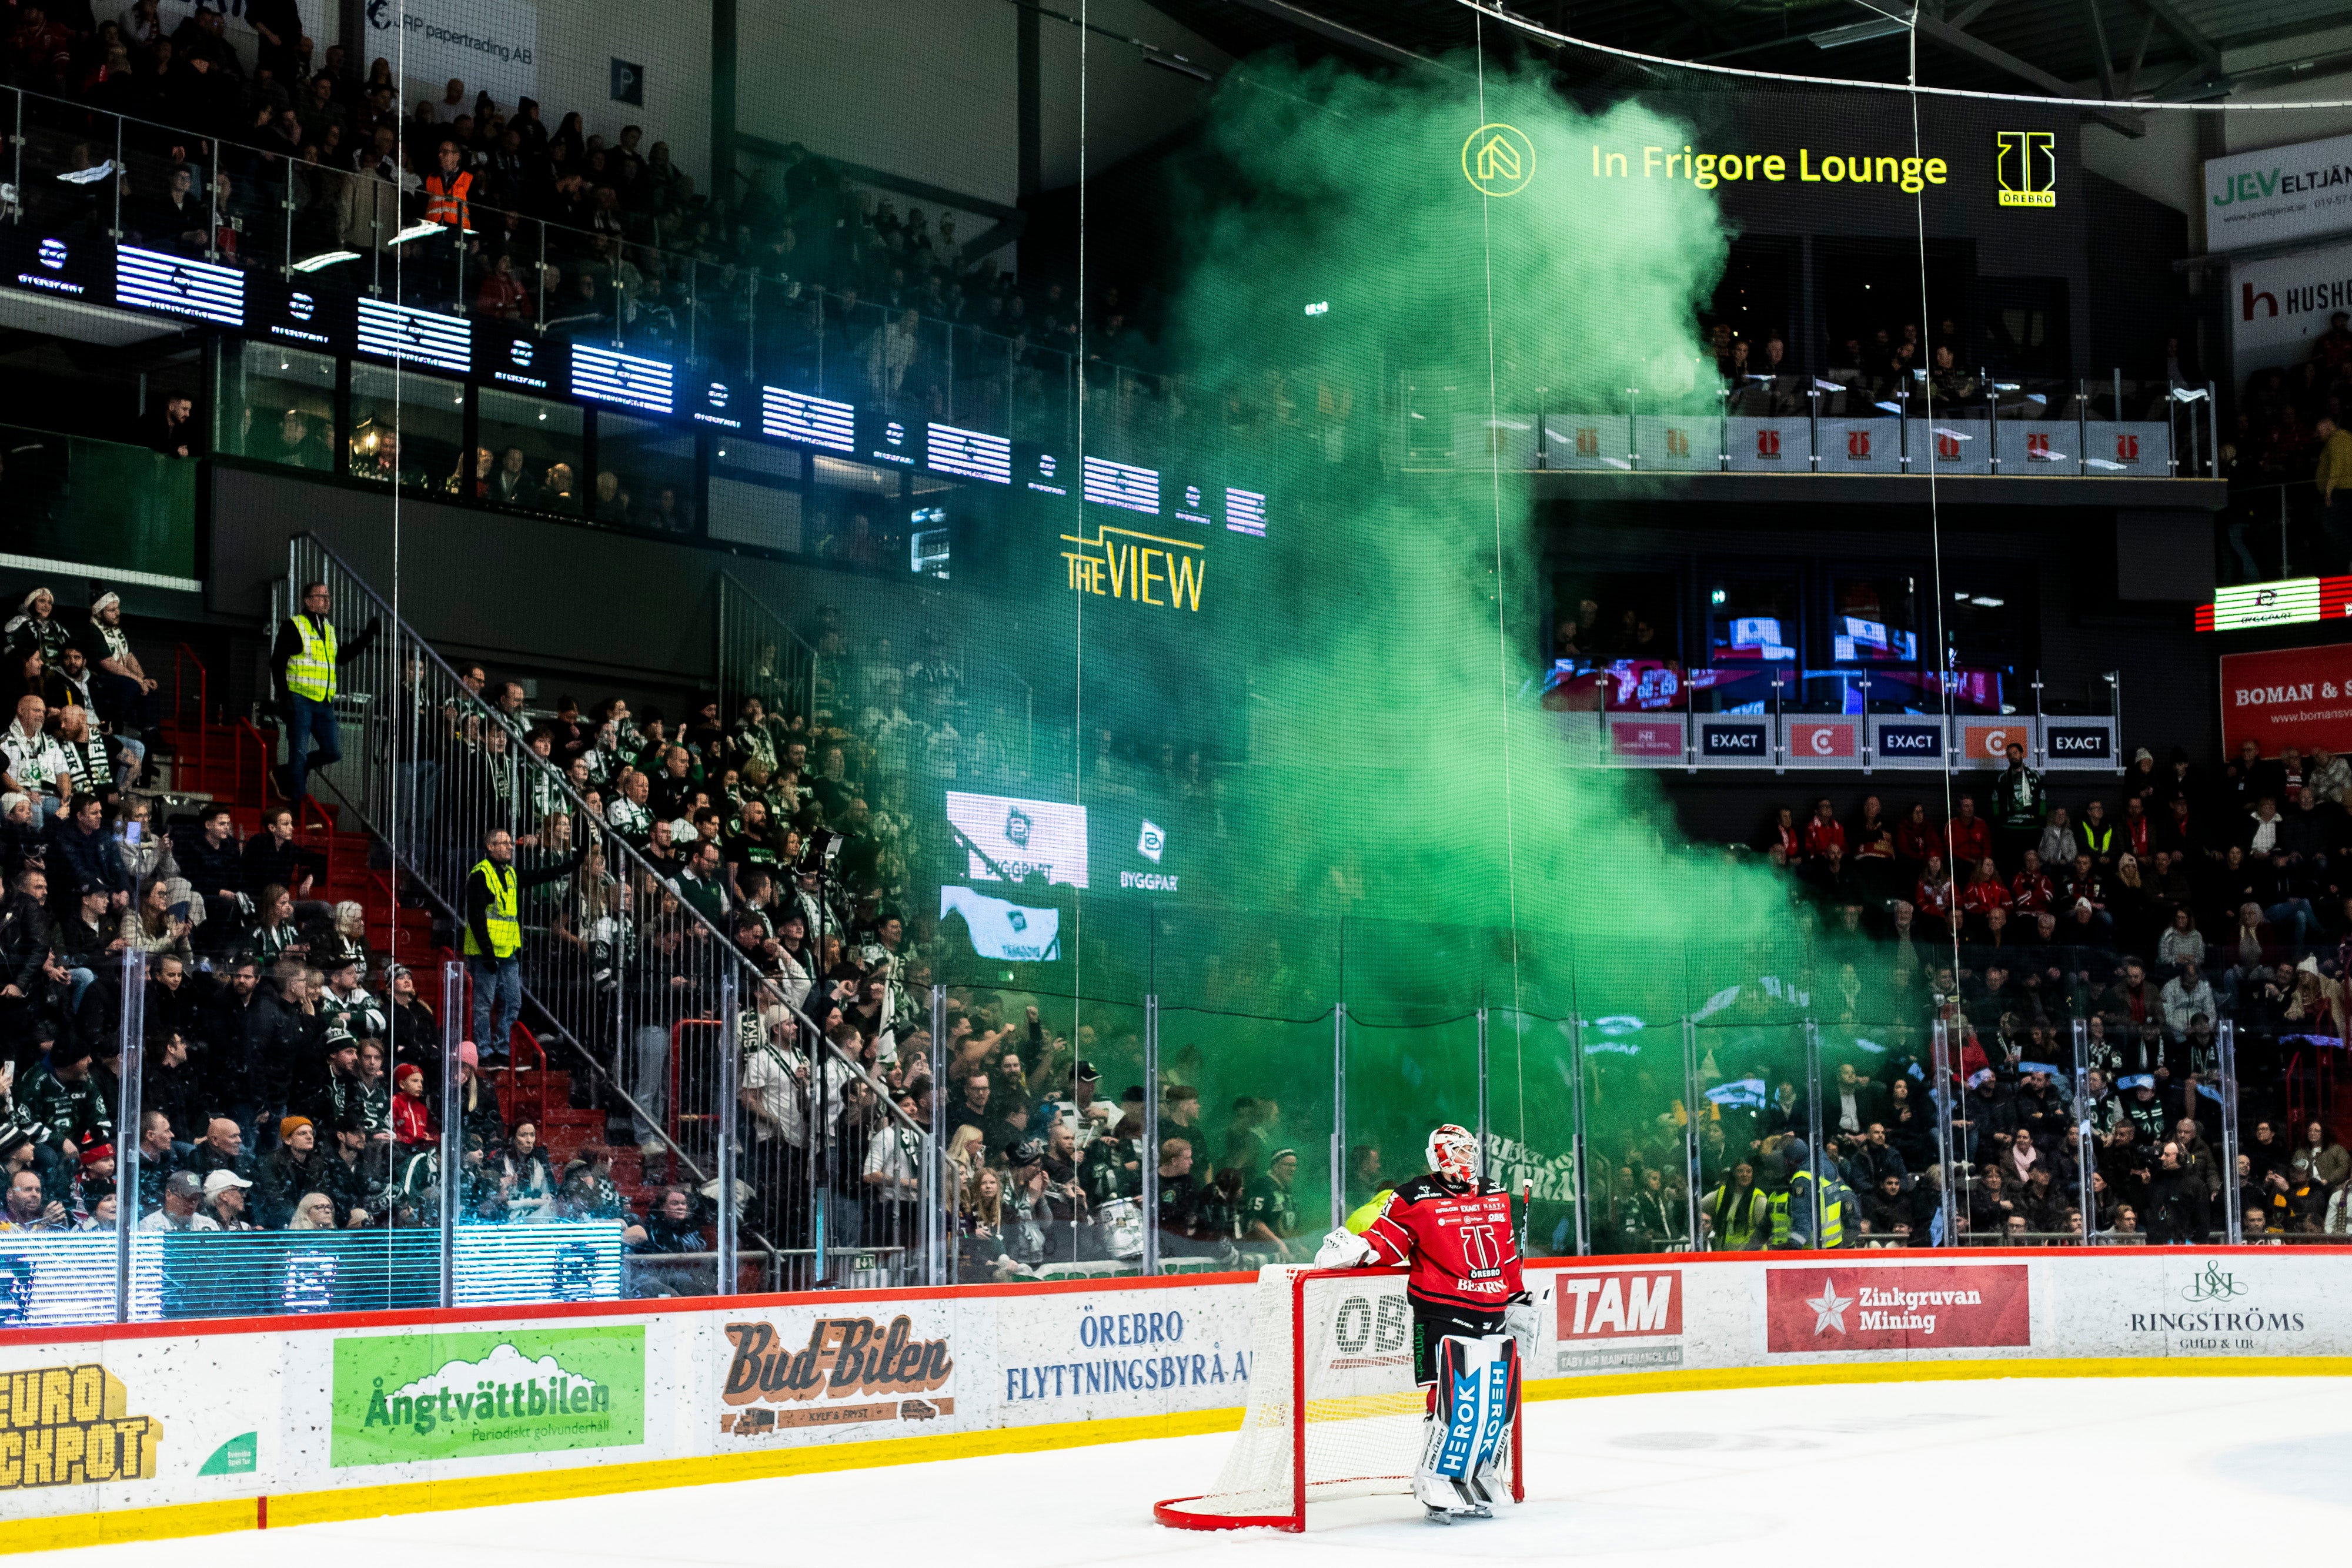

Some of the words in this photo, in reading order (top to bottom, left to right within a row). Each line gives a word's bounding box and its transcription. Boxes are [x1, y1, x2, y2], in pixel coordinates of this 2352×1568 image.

[426, 24, 509, 63] papertrading
[513, 45, 532, 65] AB
[620, 67, 634, 95] P
[1592, 145, 1628, 178] In
[1646, 145, 1786, 189] Frigore
[1800, 149, 1948, 193] Lounge
[2003, 192, 2053, 204] ÖREBRO
[1061, 551, 1105, 595] THE
[1106, 540, 1205, 611] VIEW
[2235, 683, 2314, 707] BOMAN
[2321, 681, 2338, 699] &
[1712, 734, 1758, 748] EXACT
[1886, 734, 1933, 748] EXACT
[2056, 737, 2102, 751] EXACT
[1459, 1203, 1480, 1213] EXACT
[1470, 1268, 1501, 1279] ÖREBRO
[1566, 1276, 1672, 1335] TAM
[1859, 1286, 1982, 1311] Zinkgruvan
[1080, 1304, 1184, 1349] ÖREBRO
[1335, 1295, 1414, 1355] OB
[1859, 1310, 1936, 1335] Mining
[2131, 1306, 2305, 1332] RINGSTRÖMS
[2180, 1339, 2217, 1349] GULD
[2220, 1339, 2230, 1349] &
[2235, 1339, 2254, 1349] UR
[722, 1313, 954, 1402] Bud-Bilen
[1585, 1355, 1599, 1366] AIR
[1601, 1352, 1664, 1365] MAINTENANCE
[1666, 1351, 1679, 1362] AB
[1006, 1341, 1225, 1401] FLYTTNINGSBYRÅ
[1232, 1351, 1253, 1383] A
[363, 1376, 610, 1436] Ångtvättbilen
[1479, 1368, 1504, 1455] HEROK
[472, 1426, 530, 1442] Periodiskt
[533, 1419, 610, 1442] golvunderhåll
[1442, 1385, 1476, 1471] HEROK
[227, 1450, 251, 1459] Svenska
[1428, 1427, 1445, 1471] BAUER
[228, 1459, 242, 1467] Spel
